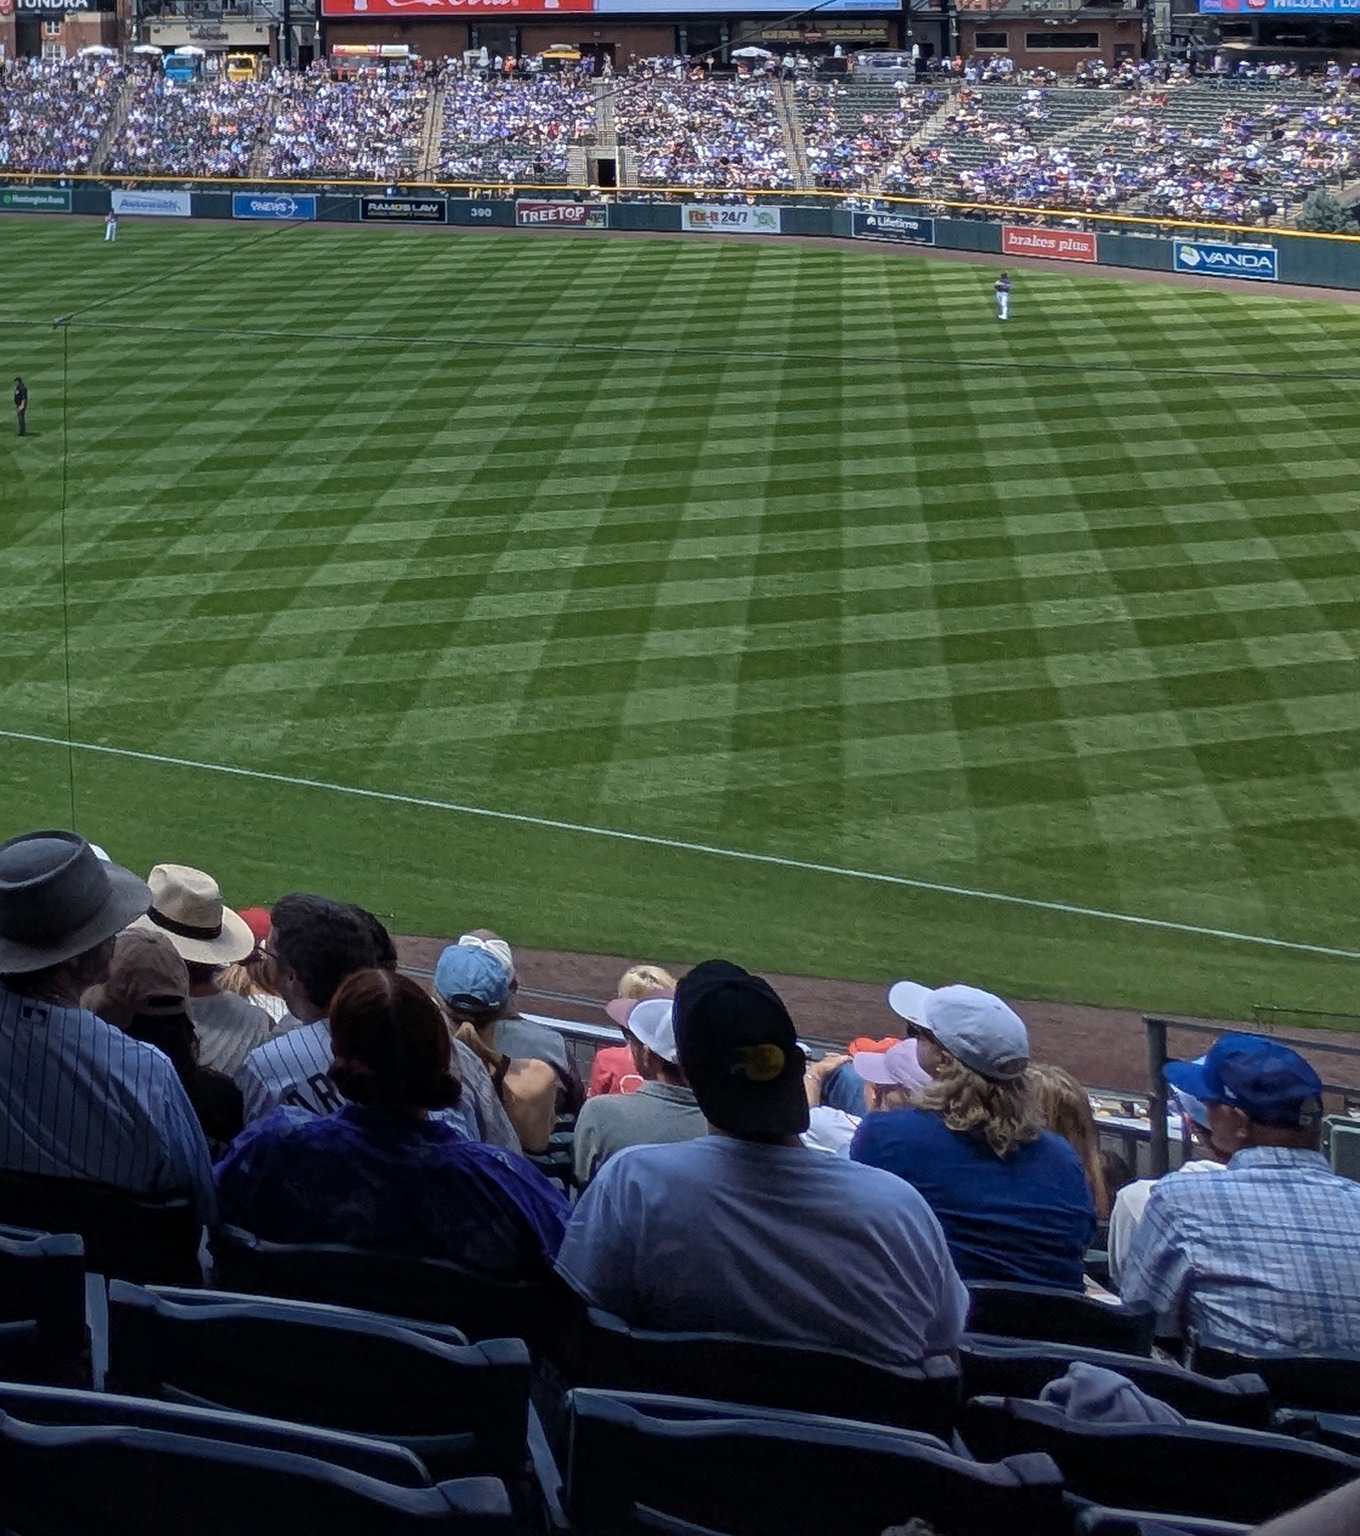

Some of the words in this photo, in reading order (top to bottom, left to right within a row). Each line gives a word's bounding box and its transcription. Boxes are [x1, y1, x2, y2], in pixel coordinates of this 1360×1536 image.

[721, 211, 748, 222] 24/7
[1008, 233, 1055, 248] brakes
[1058, 238, 1090, 253] plus.
[1200, 251, 1273, 268] VANDA
